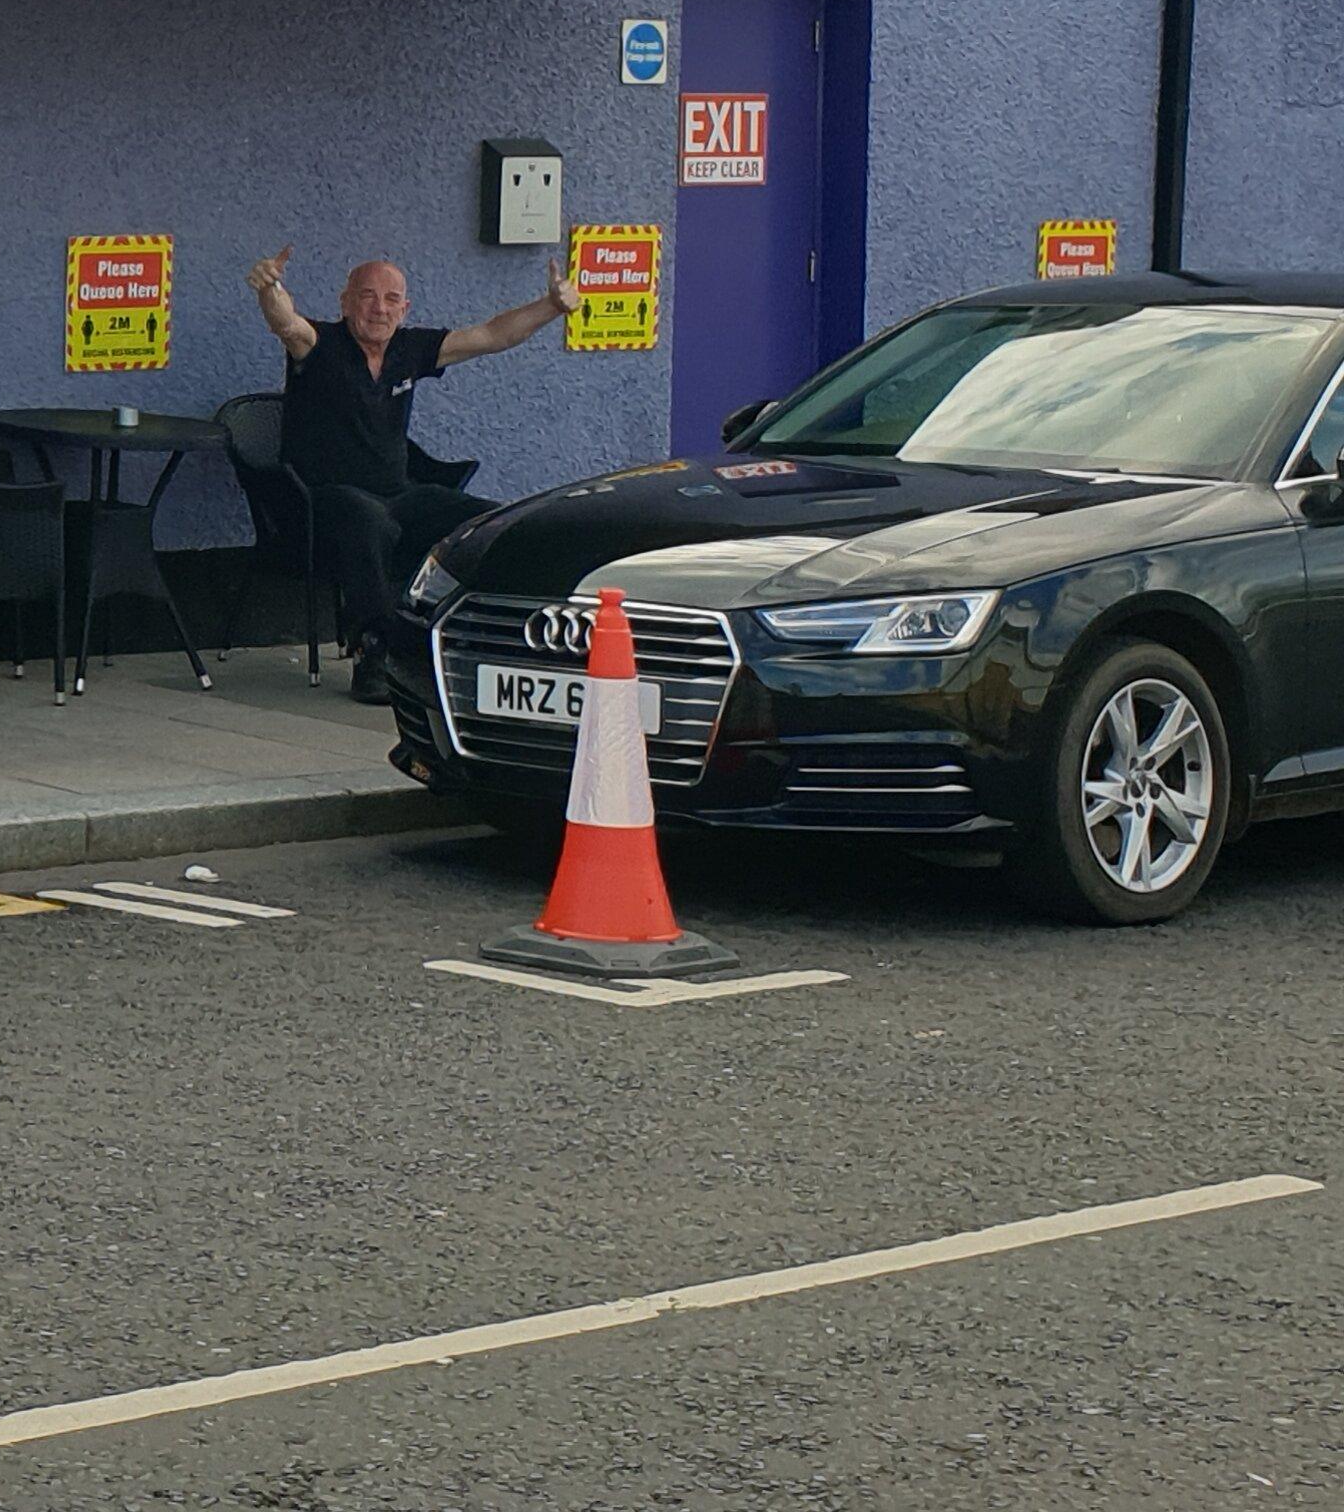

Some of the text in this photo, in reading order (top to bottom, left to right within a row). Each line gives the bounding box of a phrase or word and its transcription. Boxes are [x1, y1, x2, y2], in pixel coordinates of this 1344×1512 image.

[684, 100, 767, 153] EXIT
[687, 161, 759, 178] KEEP CLEAR
[596, 248, 638, 264] Please
[98, 261, 144, 277] Please
[80, 282, 160, 301] Queue Here
[604, 300, 625, 313] 2M
[108, 317, 130, 330] 2M
[497, 673, 557, 714] MRZ
